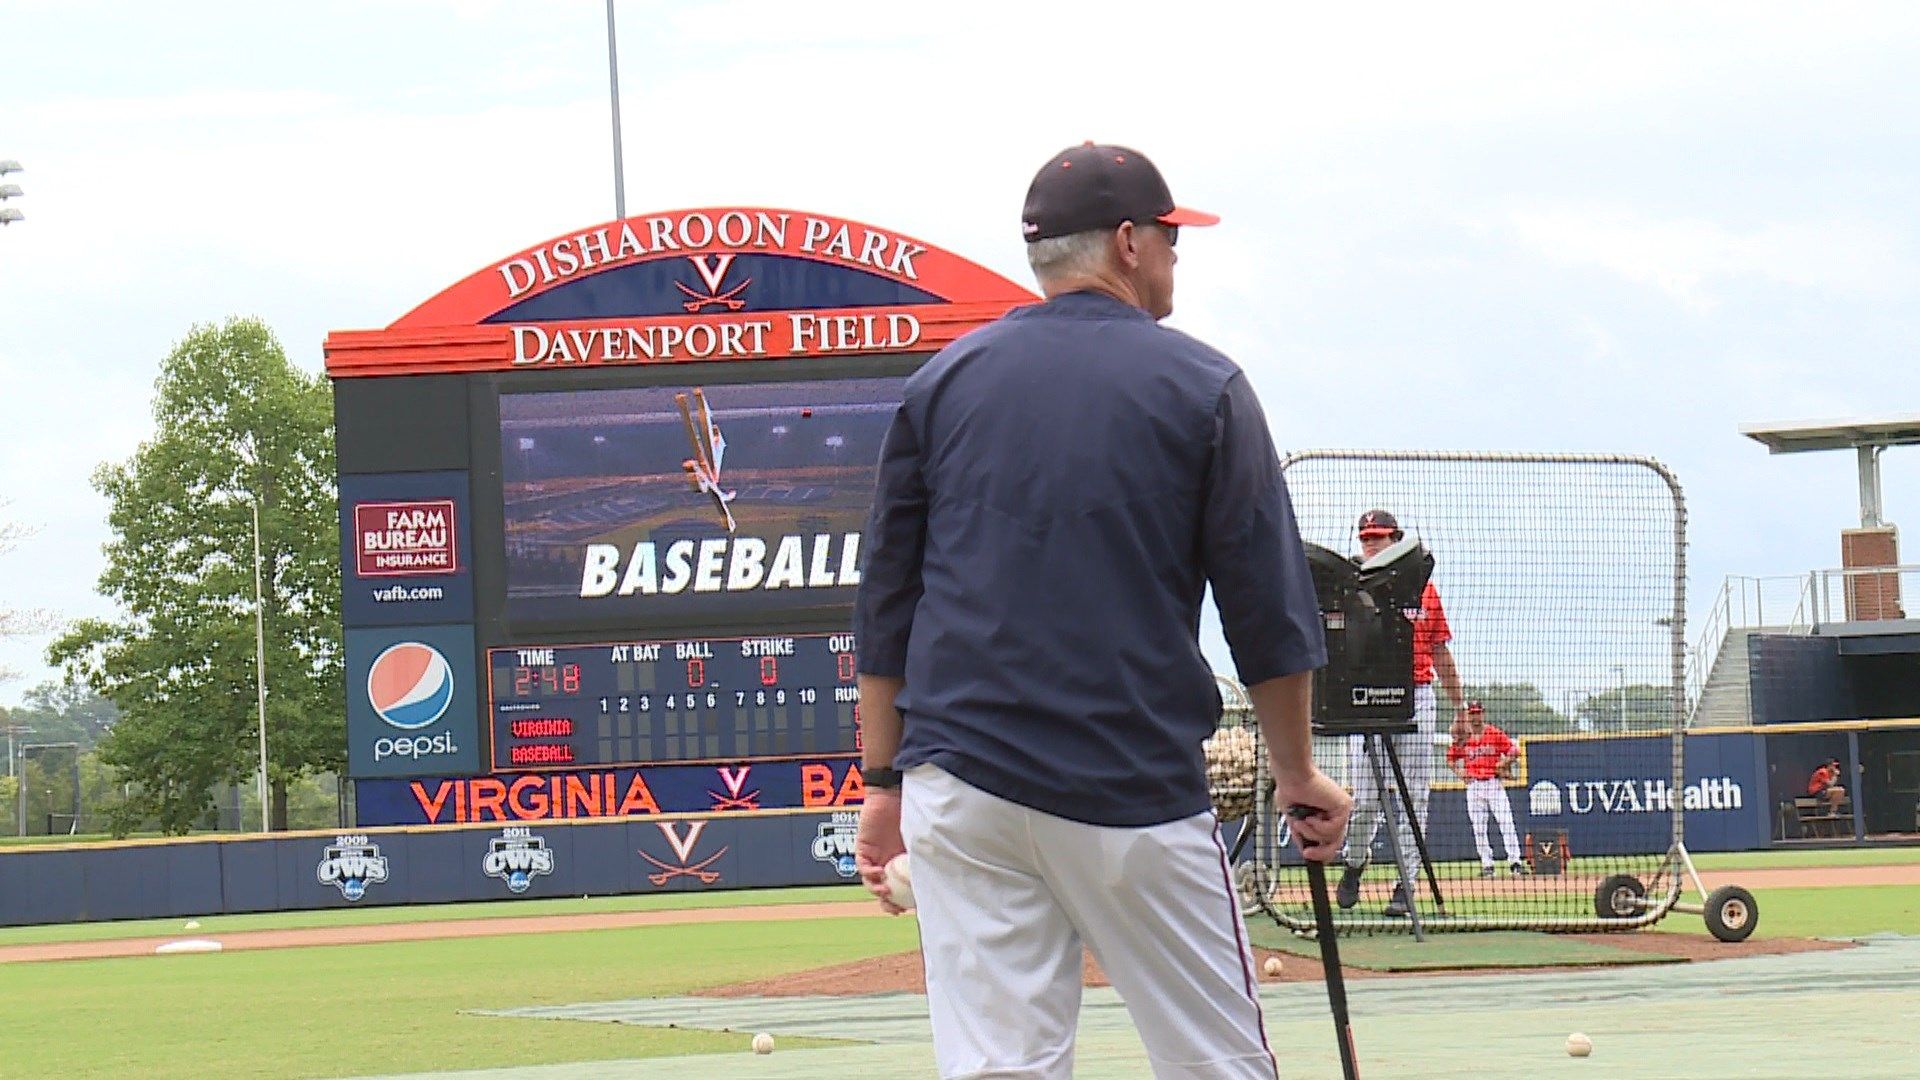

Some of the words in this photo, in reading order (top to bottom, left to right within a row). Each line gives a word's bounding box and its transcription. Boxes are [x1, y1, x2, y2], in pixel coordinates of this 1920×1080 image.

[497, 212, 791, 298] DISHAROON
[800, 217, 928, 280] PARK
[511, 320, 771, 366] DAVENPORT
[788, 313, 920, 353] FIELD
[387, 510, 446, 531] FARM
[364, 528, 447, 551] BUREAU
[376, 553, 448, 568] INSURANCE
[580, 533, 862, 599] BASEBALL
[373, 586, 443, 602] vafb.com
[517, 649, 555, 667] TIME
[611, 646, 629, 663] AT
[633, 644, 661, 662] BAT
[676, 641, 713, 660] BALL
[742, 638, 795, 657] STRIKE
[515, 664, 581, 696] 2:48
[600, 697, 608, 713] 1
[619, 697, 629, 712] 2
[640, 696, 650, 711] 3
[666, 694, 676, 710] 4
[686, 694, 695, 708] 5
[706, 693, 715, 708] 6
[736, 692, 745, 706] 7
[756, 690, 765, 705] 8
[776, 690, 786, 705] 9
[800, 689, 815, 703] 10
[512, 720, 572, 738] VIRGINIA
[512, 744, 574, 763] BASEBALL
[410, 771, 662, 824] VIRGINIA
[802, 763, 865, 808] BA
[336, 835, 368, 847] 2009
[503, 826, 531, 839] 2011
[319, 856, 386, 881] CWS
[485, 848, 552, 874] CWS
